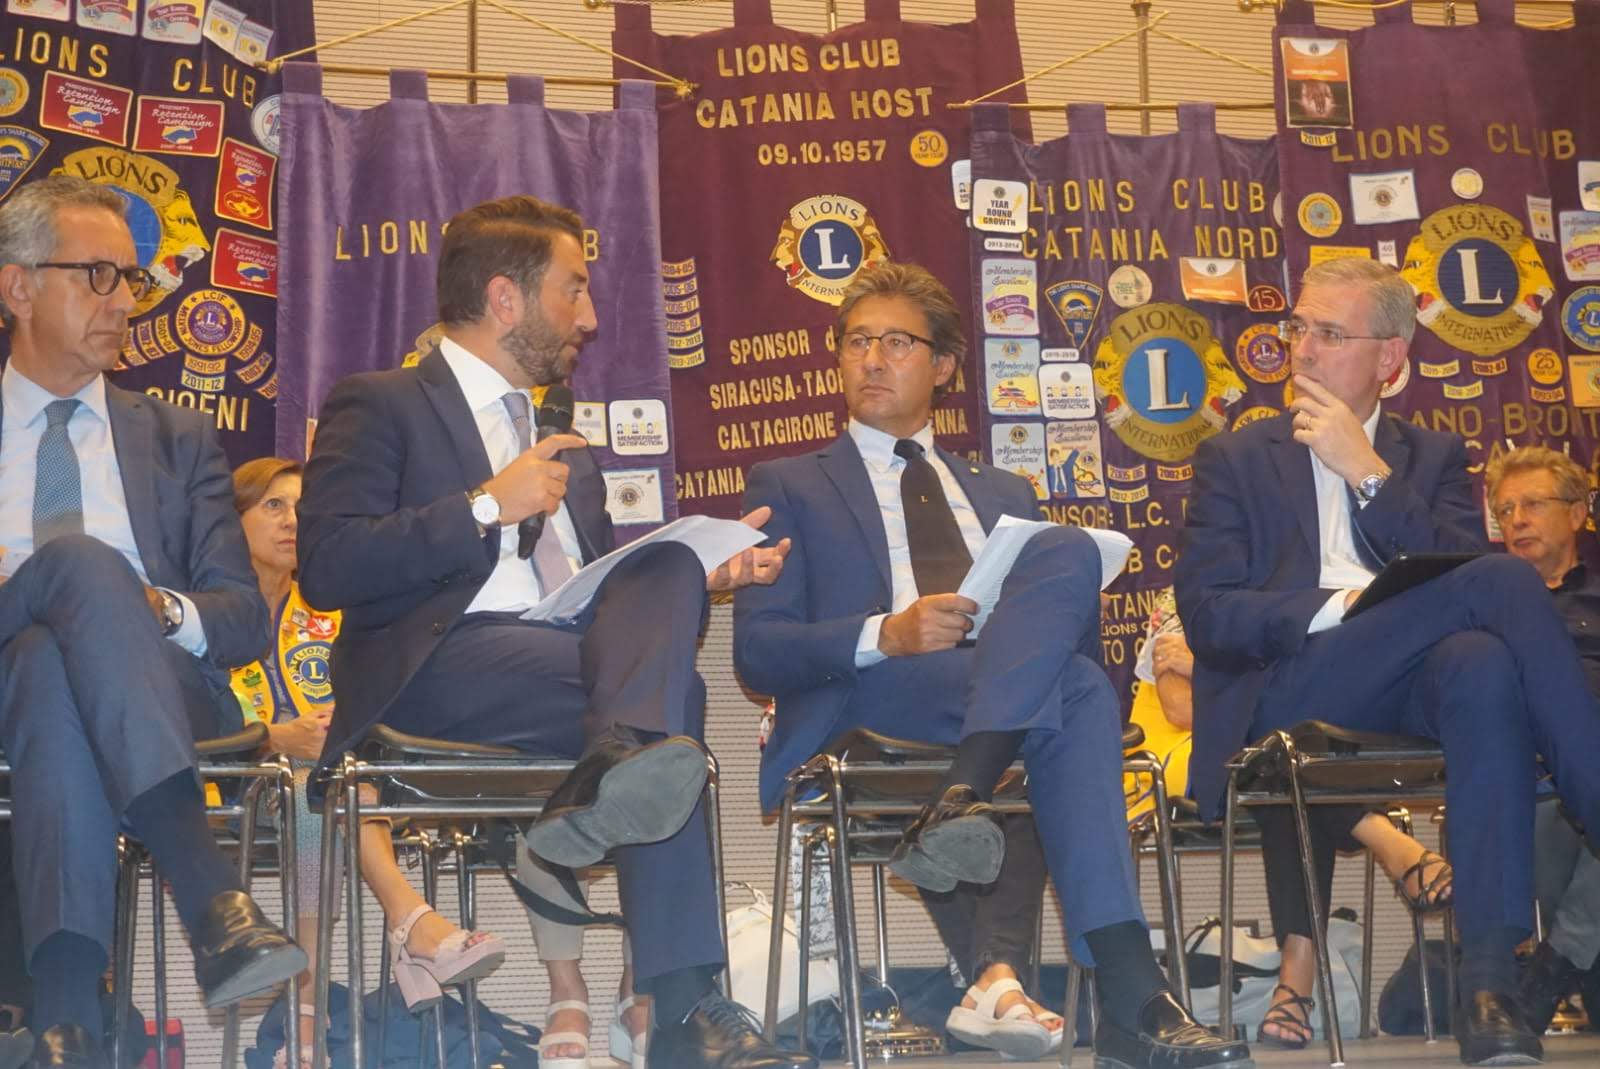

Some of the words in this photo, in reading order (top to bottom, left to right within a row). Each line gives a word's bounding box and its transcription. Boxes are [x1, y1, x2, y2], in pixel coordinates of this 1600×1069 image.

[717, 43, 809, 77] LIONS
[819, 38, 900, 71] CLUB
[173, 58, 257, 109] CLUB
[152, 107, 208, 122] Retention
[696, 91, 836, 129] CATANIA
[851, 86, 933, 120] HOST
[758, 139, 887, 166] 09.10.1957
[918, 136, 941, 153] 50
[1331, 125, 1451, 163] LIONS
[1487, 123, 1577, 160] CLUB
[77, 156, 168, 195] LIONS
[990, 199, 1009, 209] YEAR
[1029, 178, 1136, 215] LIONS
[1173, 177, 1266, 213] CLUB
[798, 201, 860, 222] LIONS
[983, 216, 1016, 226] GROWTH
[987, 207, 1012, 218] ROUND
[1430, 212, 1515, 241] LIONS
[335, 220, 450, 261] LION
[814, 228, 851, 270] L
[1020, 227, 1169, 261] CATANIA
[1194, 225, 1278, 259] NORD
[1456, 249, 1504, 305] L
[203, 290, 227, 302] LCIF
[1253, 289, 1275, 309] 15
[1119, 310, 1205, 343] LIONS
[729, 328, 810, 365] SPONSOR
[1535, 352, 1555, 369] 25
[1144, 348, 1190, 411] L
[617, 434, 662, 442] MEMBERSHIP
[617, 440, 664, 448] SATISFACTION
[718, 411, 837, 451] CALTAGIRONE
[1120, 418, 1212, 450] INTERNATIONAL
[674, 466, 746, 500] CATANIA
[1125, 502, 1170, 529] L.C.
[296, 645, 331, 660] LIONS
[309, 661, 324, 679] L
